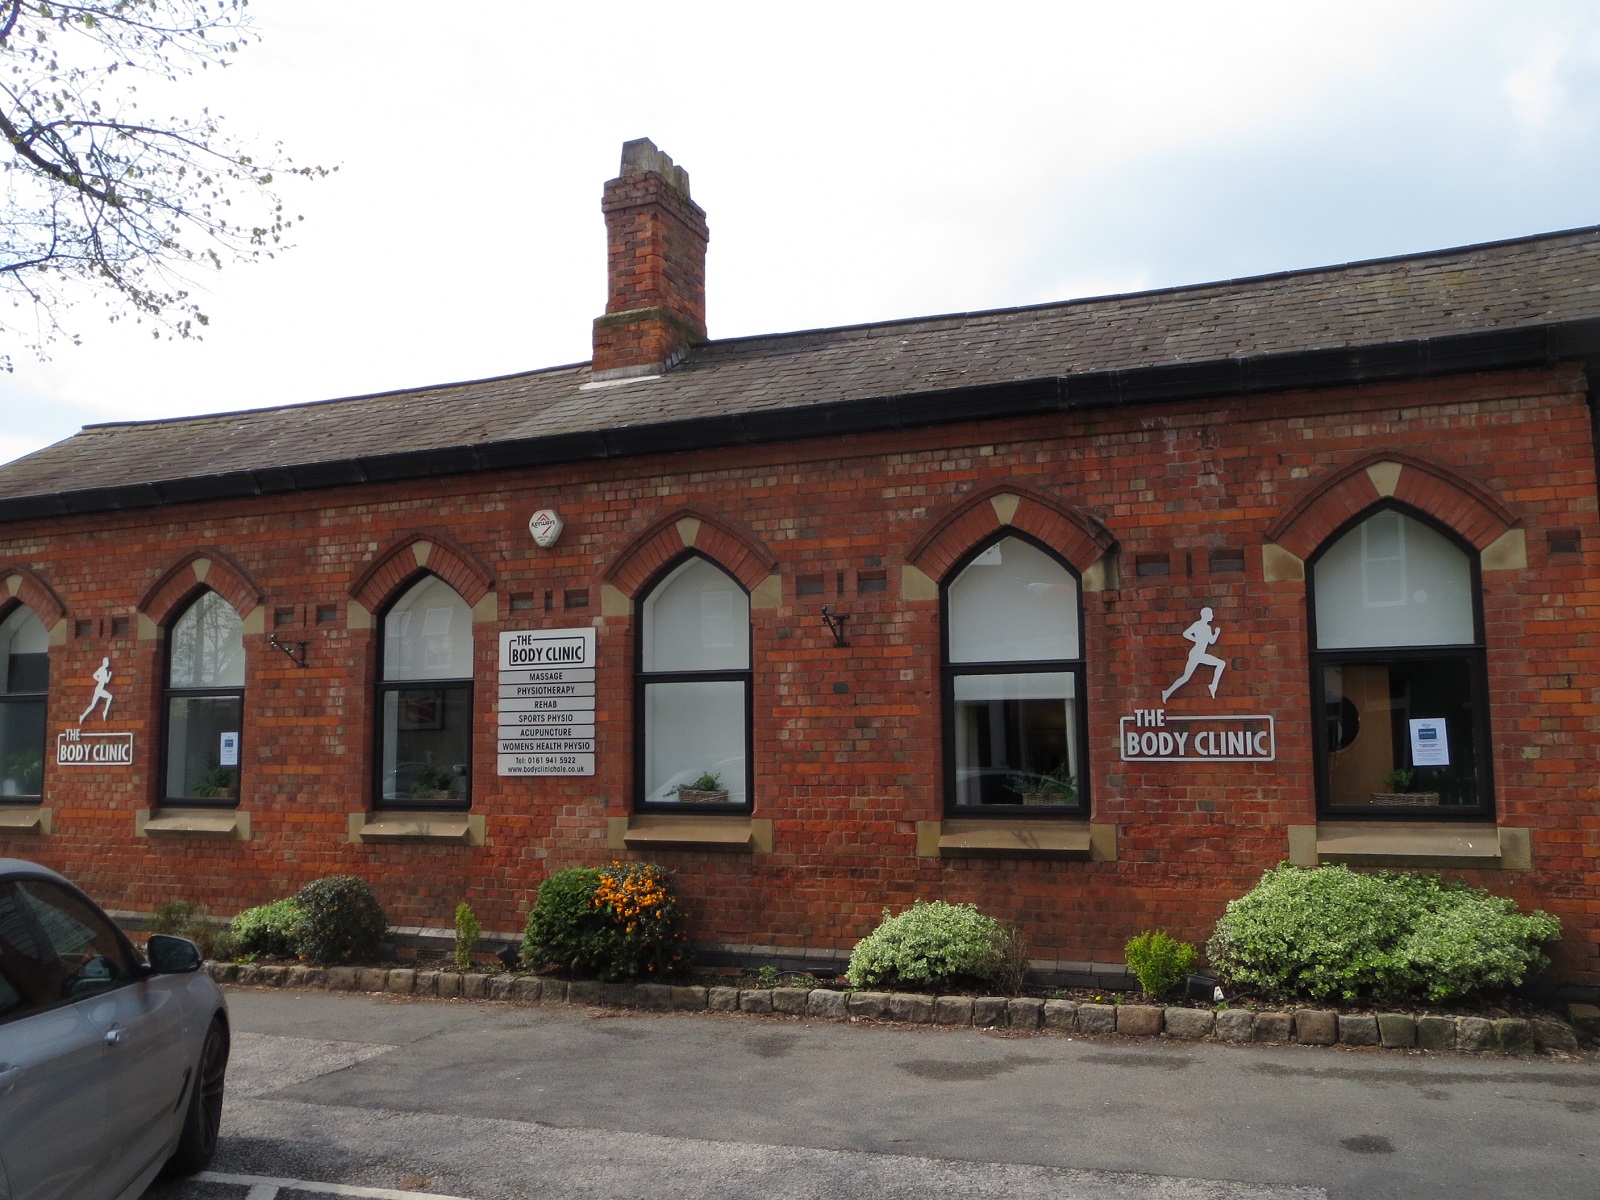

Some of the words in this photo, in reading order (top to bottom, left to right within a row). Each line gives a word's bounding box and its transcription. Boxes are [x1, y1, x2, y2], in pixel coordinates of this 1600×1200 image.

[531, 520, 555, 528] KEYWAYS
[517, 635, 532, 646] THE
[512, 648, 543, 663] BODY
[545, 646, 582, 661] CLINIC
[529, 672, 563, 681] MASSAGE
[517, 686, 575, 695] PHYSIOTHERAPY
[534, 701, 557, 709] REHAB
[518, 714, 545, 723] SPORTS
[547, 714, 573, 722] PHYSIO
[1134, 709, 1165, 727] THE
[65, 729, 80, 741] THE
[520, 728, 572, 737] ACUPUNCTURE
[502, 742, 534, 751] WOMENS
[536, 743, 562, 751] HEALTH
[563, 742, 590, 750] PHYSIO
[1126, 732, 1188, 755] BODY
[1194, 731, 1267, 755] CLINIC
[60, 744, 91, 761] BODY
[93, 744, 129, 761] CLINIC
[507, 765, 584, 774] www.bodyclinichale.co.uk
